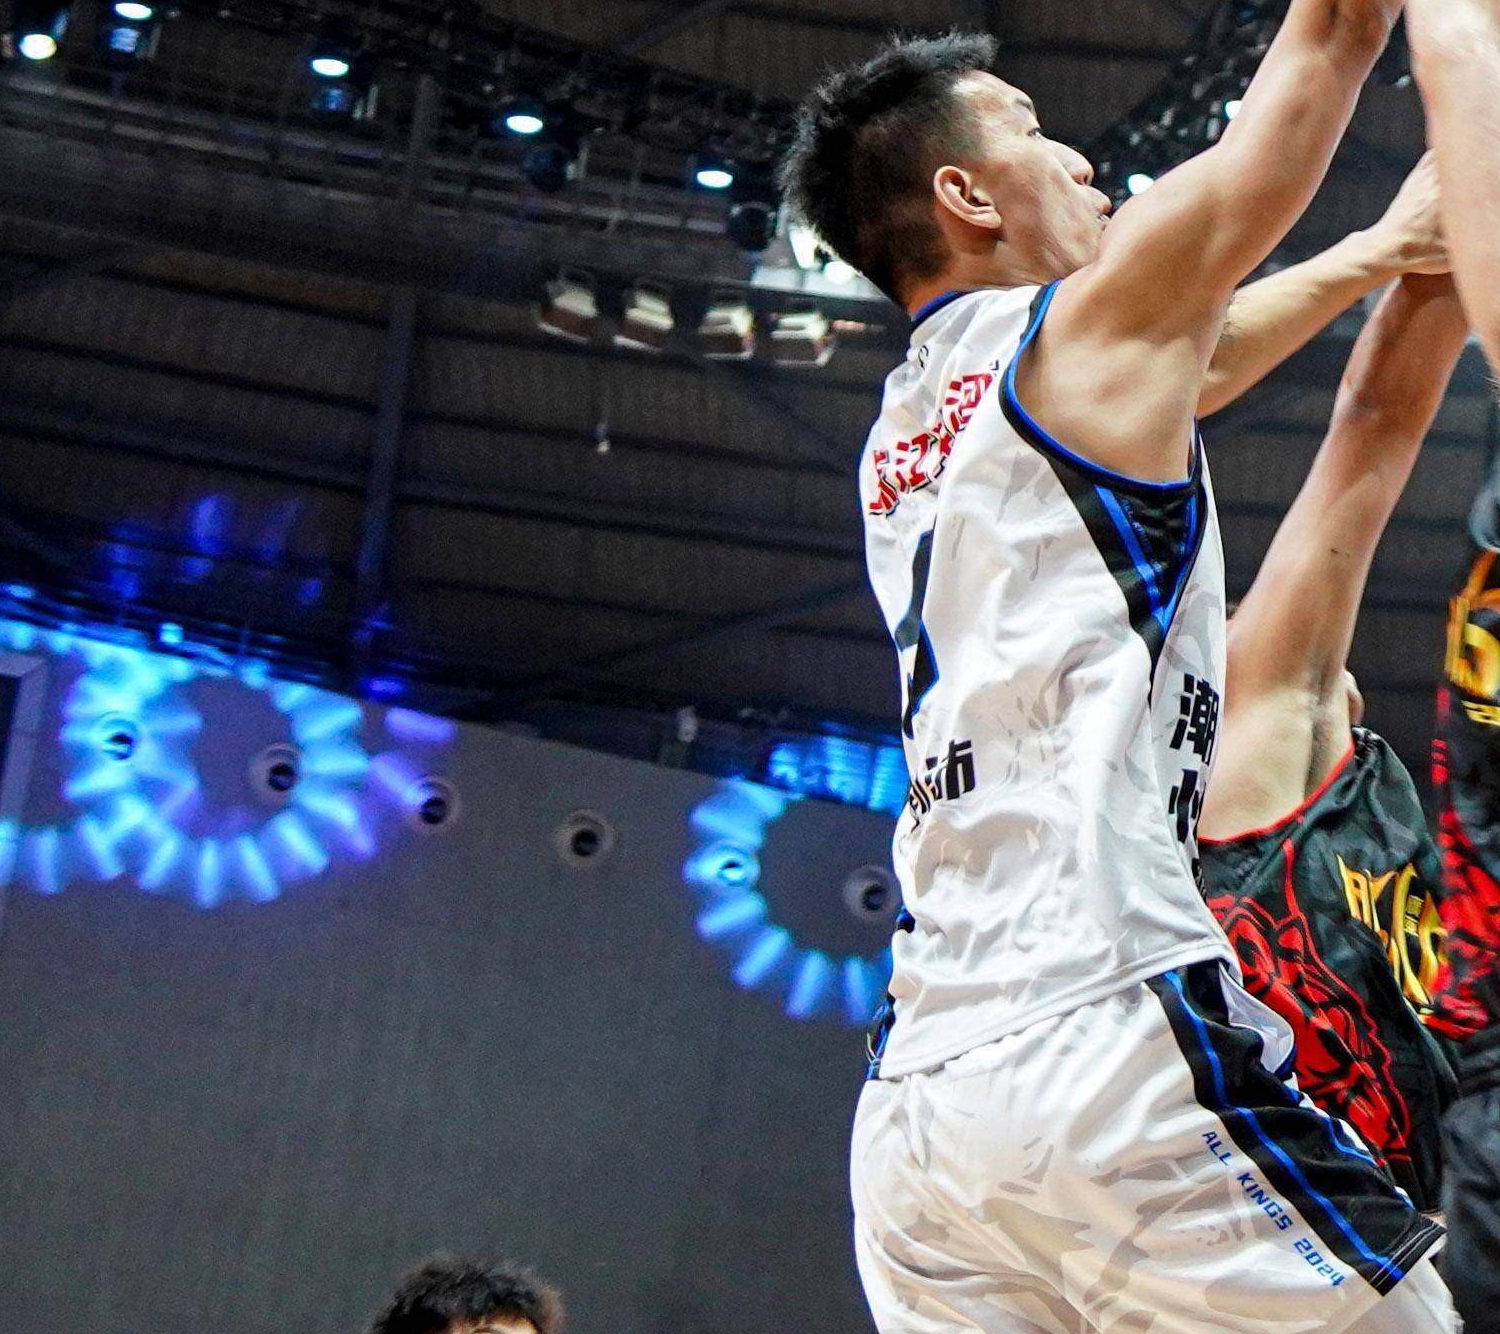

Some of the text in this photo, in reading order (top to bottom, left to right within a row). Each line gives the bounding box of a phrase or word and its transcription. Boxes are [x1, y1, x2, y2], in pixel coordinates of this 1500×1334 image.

[1202, 1131, 1346, 1286] ALL KINGS 2024
